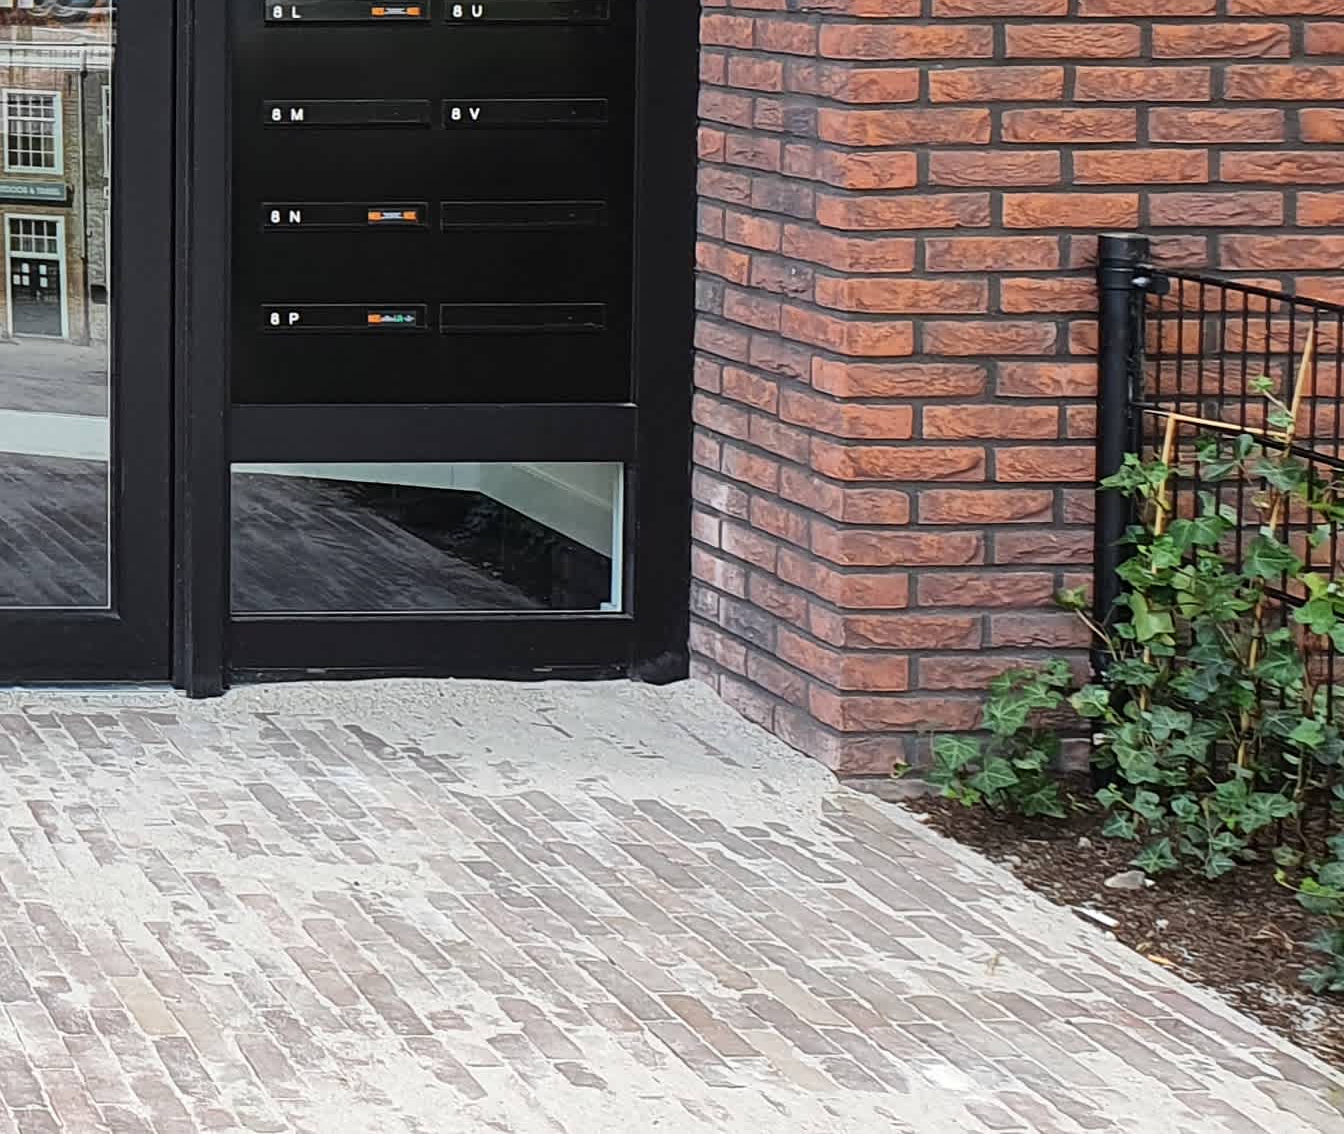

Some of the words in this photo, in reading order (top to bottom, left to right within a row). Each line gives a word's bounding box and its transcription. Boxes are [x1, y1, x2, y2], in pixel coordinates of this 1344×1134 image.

[272, 5, 283, 19] 8
[291, 5, 302, 19] L
[452, 4, 463, 18] 8
[471, 4, 483, 18] U
[271, 108, 282, 121] 8
[290, 108, 304, 121] M
[451, 107, 461, 121] 8
[469, 107, 481, 120] V
[270, 210, 281, 224] 8
[289, 210, 301, 223] N
[270, 312, 280, 326] 8
[288, 312, 300, 325] P
